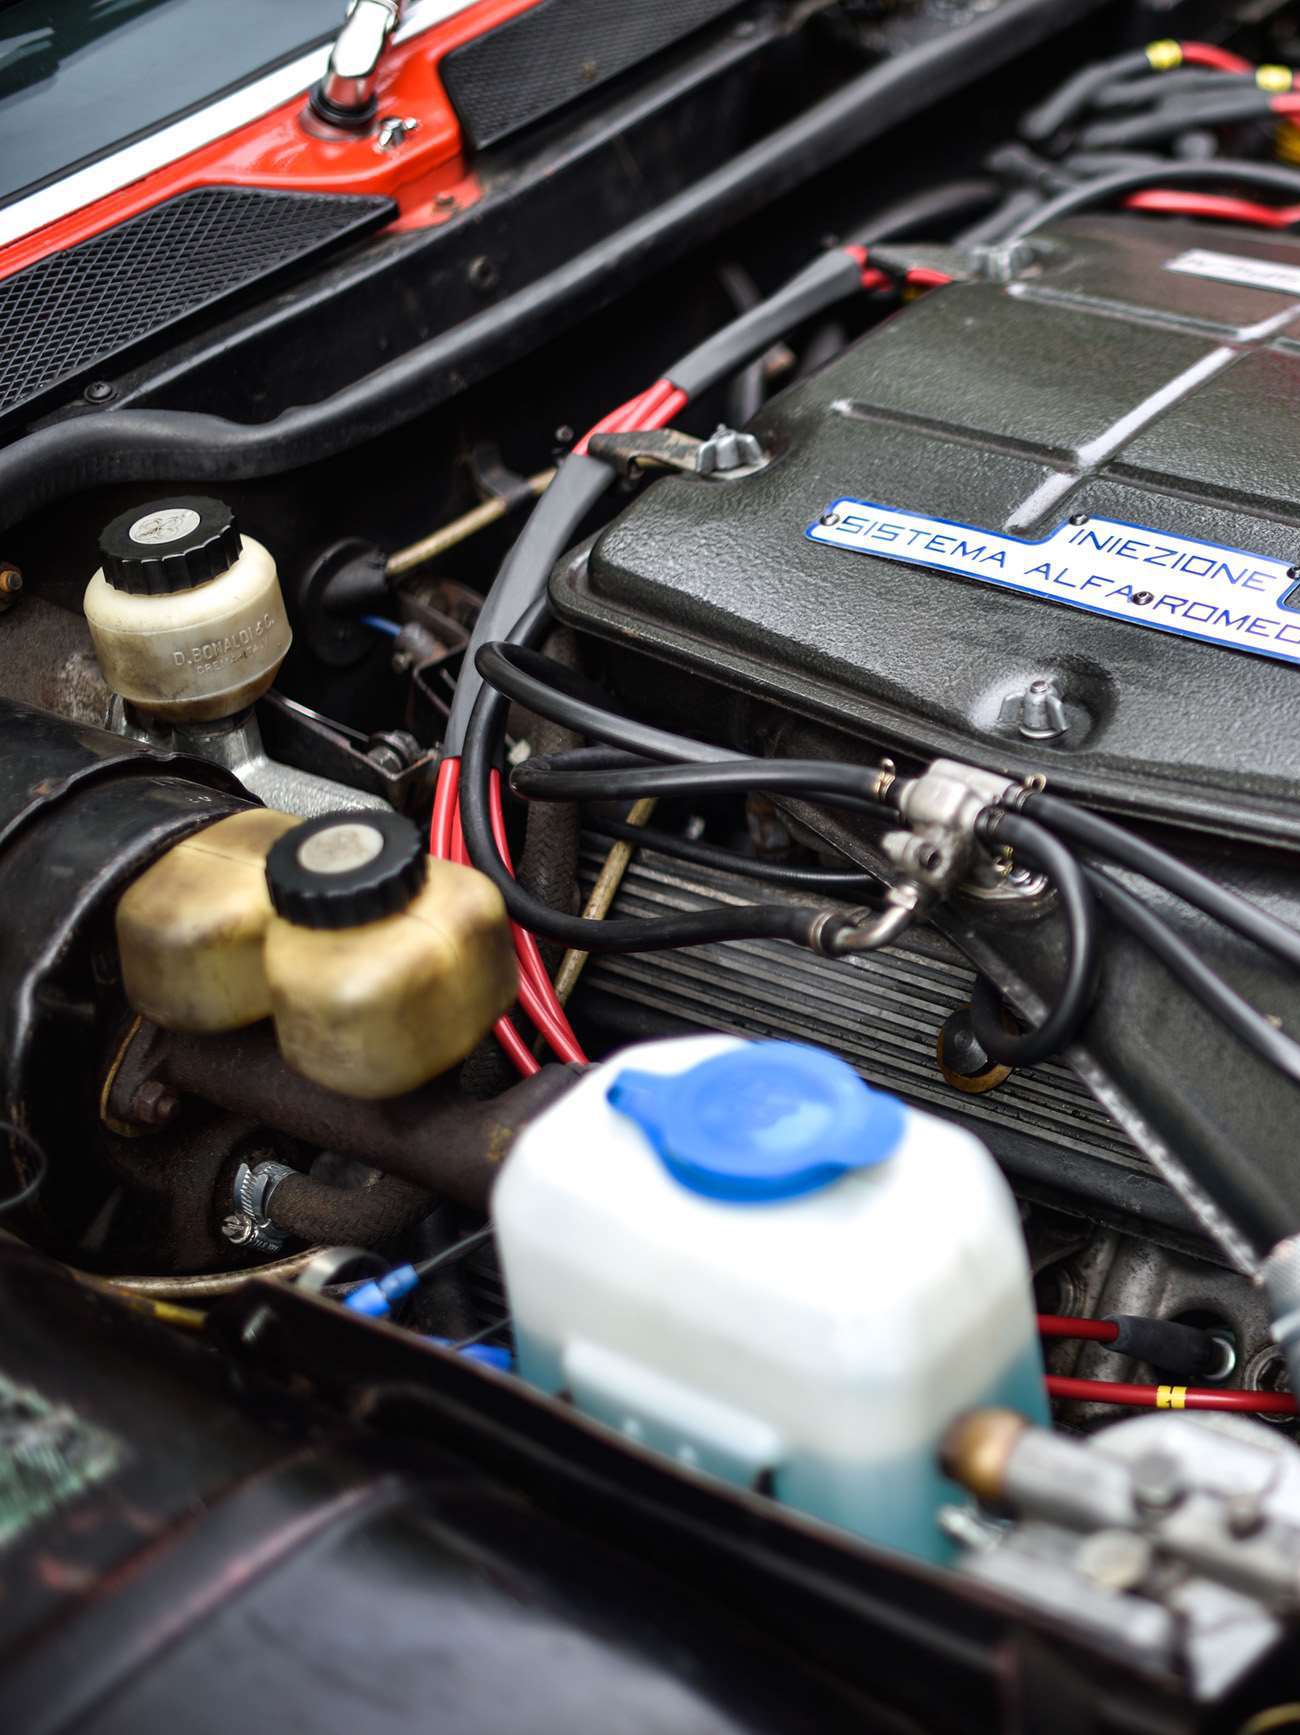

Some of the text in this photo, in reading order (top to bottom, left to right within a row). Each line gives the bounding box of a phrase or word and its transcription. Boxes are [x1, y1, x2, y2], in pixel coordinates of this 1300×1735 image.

[835, 515, 1007, 569] SISTEMA
[1024, 562, 1135, 604] ALFA
[1068, 528, 1277, 592] INIEZIONE
